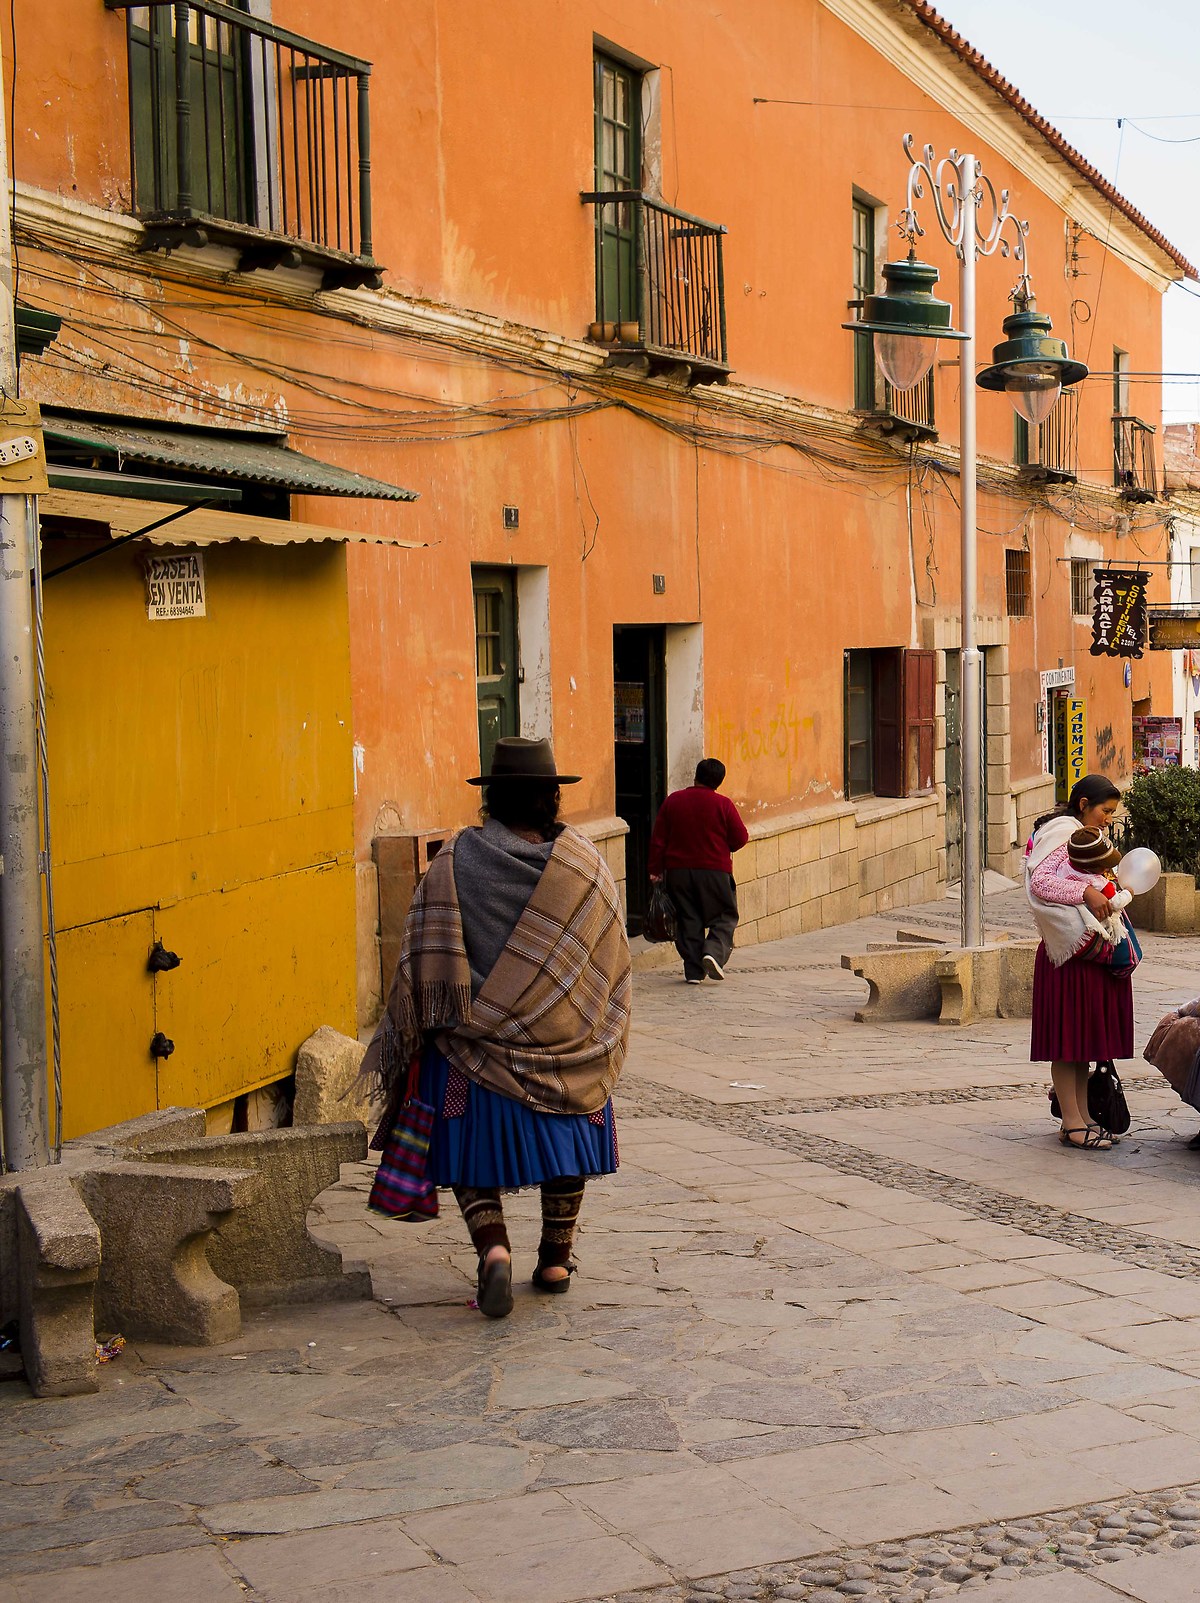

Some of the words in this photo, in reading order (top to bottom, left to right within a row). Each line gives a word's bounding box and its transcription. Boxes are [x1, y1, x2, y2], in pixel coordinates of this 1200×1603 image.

[151, 556, 200, 580] CASETA
[150, 582, 165, 606] EN
[167, 580, 203, 605] VENTA
[1097, 579, 1114, 646] FARMACIA
[1110, 584, 1140, 650] CONTINENTAL
[1126, 624, 1138, 640] TEL
[1045, 669, 1075, 686] CONTINENTAL
[1071, 700, 1084, 789] FARMACI
